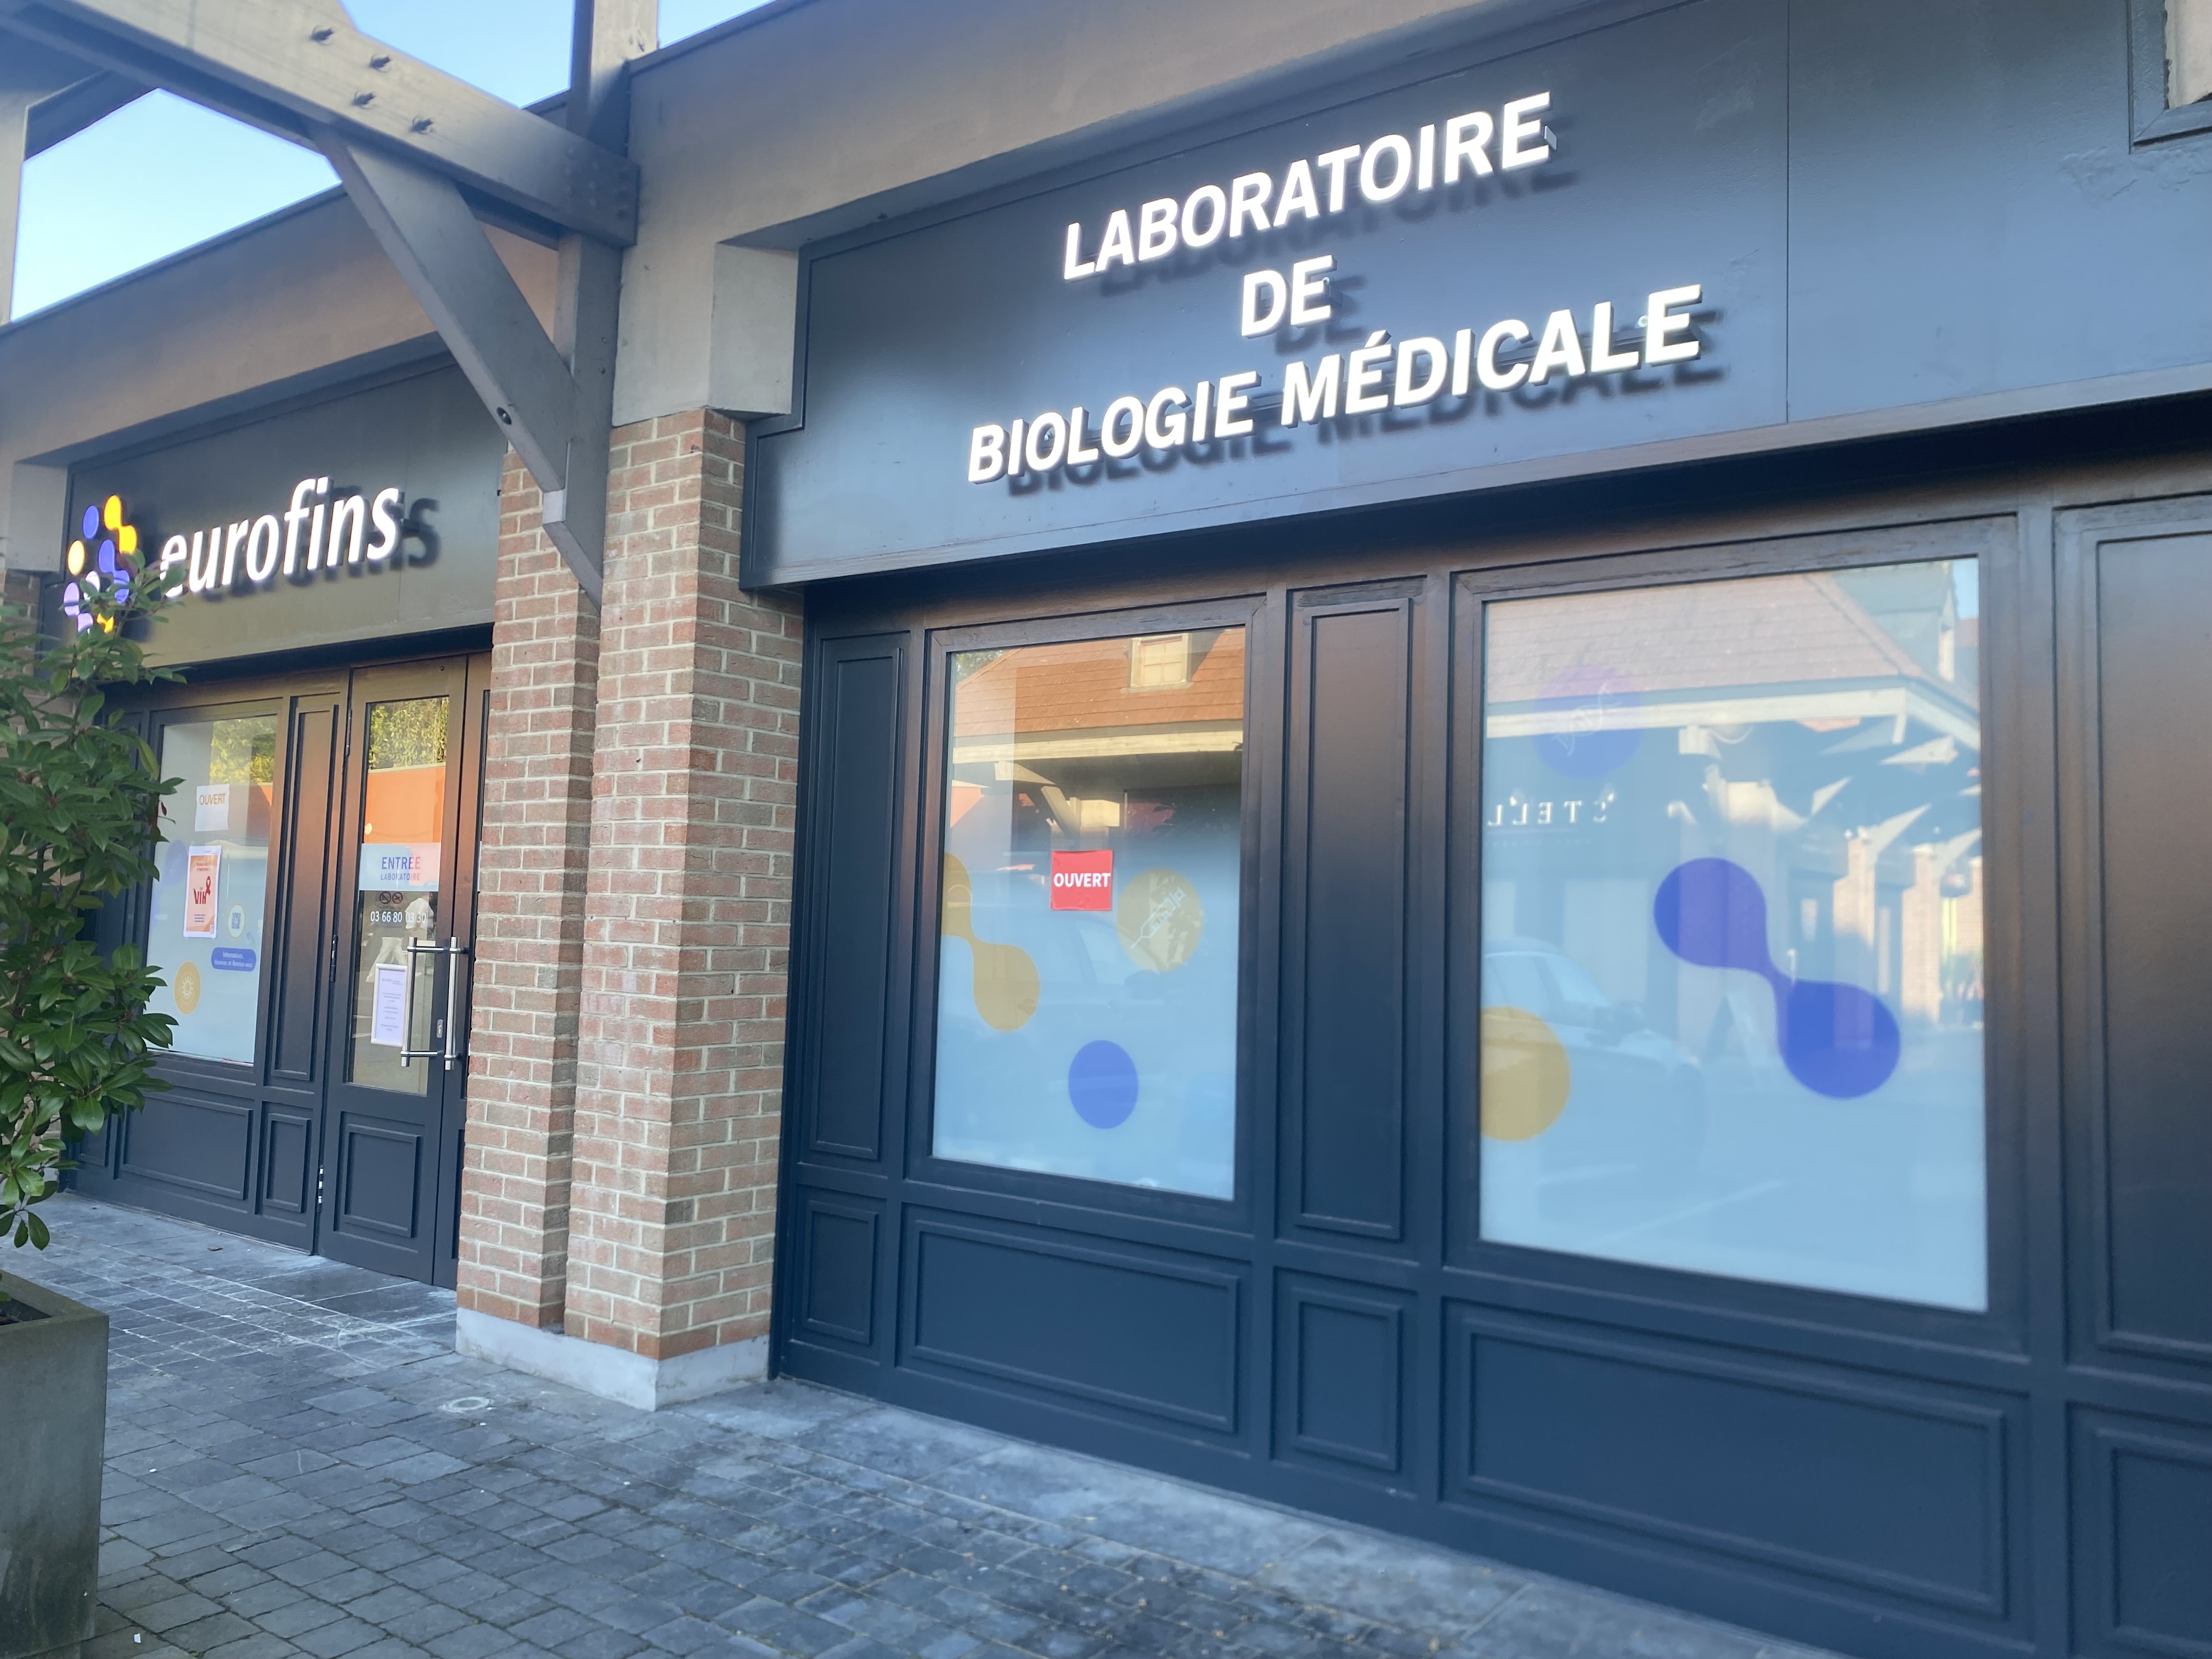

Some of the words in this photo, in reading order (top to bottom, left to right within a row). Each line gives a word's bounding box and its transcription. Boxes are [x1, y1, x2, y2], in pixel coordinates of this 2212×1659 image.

[1063, 91, 1551, 280] LABORATOIRE
[1240, 254, 1334, 337] DE
[967, 370, 1259, 483] BIOLOGIE
[1280, 284, 1701, 427] MÉDICALE
[160, 476, 400, 599] eurofins
[199, 793, 225, 805] OUVERT
[381, 854, 421, 870] ENTRÉE
[1054, 872, 1111, 887] OUVERT
[370, 911, 380, 922] 03
[382, 911, 391, 922] 66
[393, 911, 403, 923] 80
[405, 912, 414, 923] 03
[417, 912, 426, 923] 30
